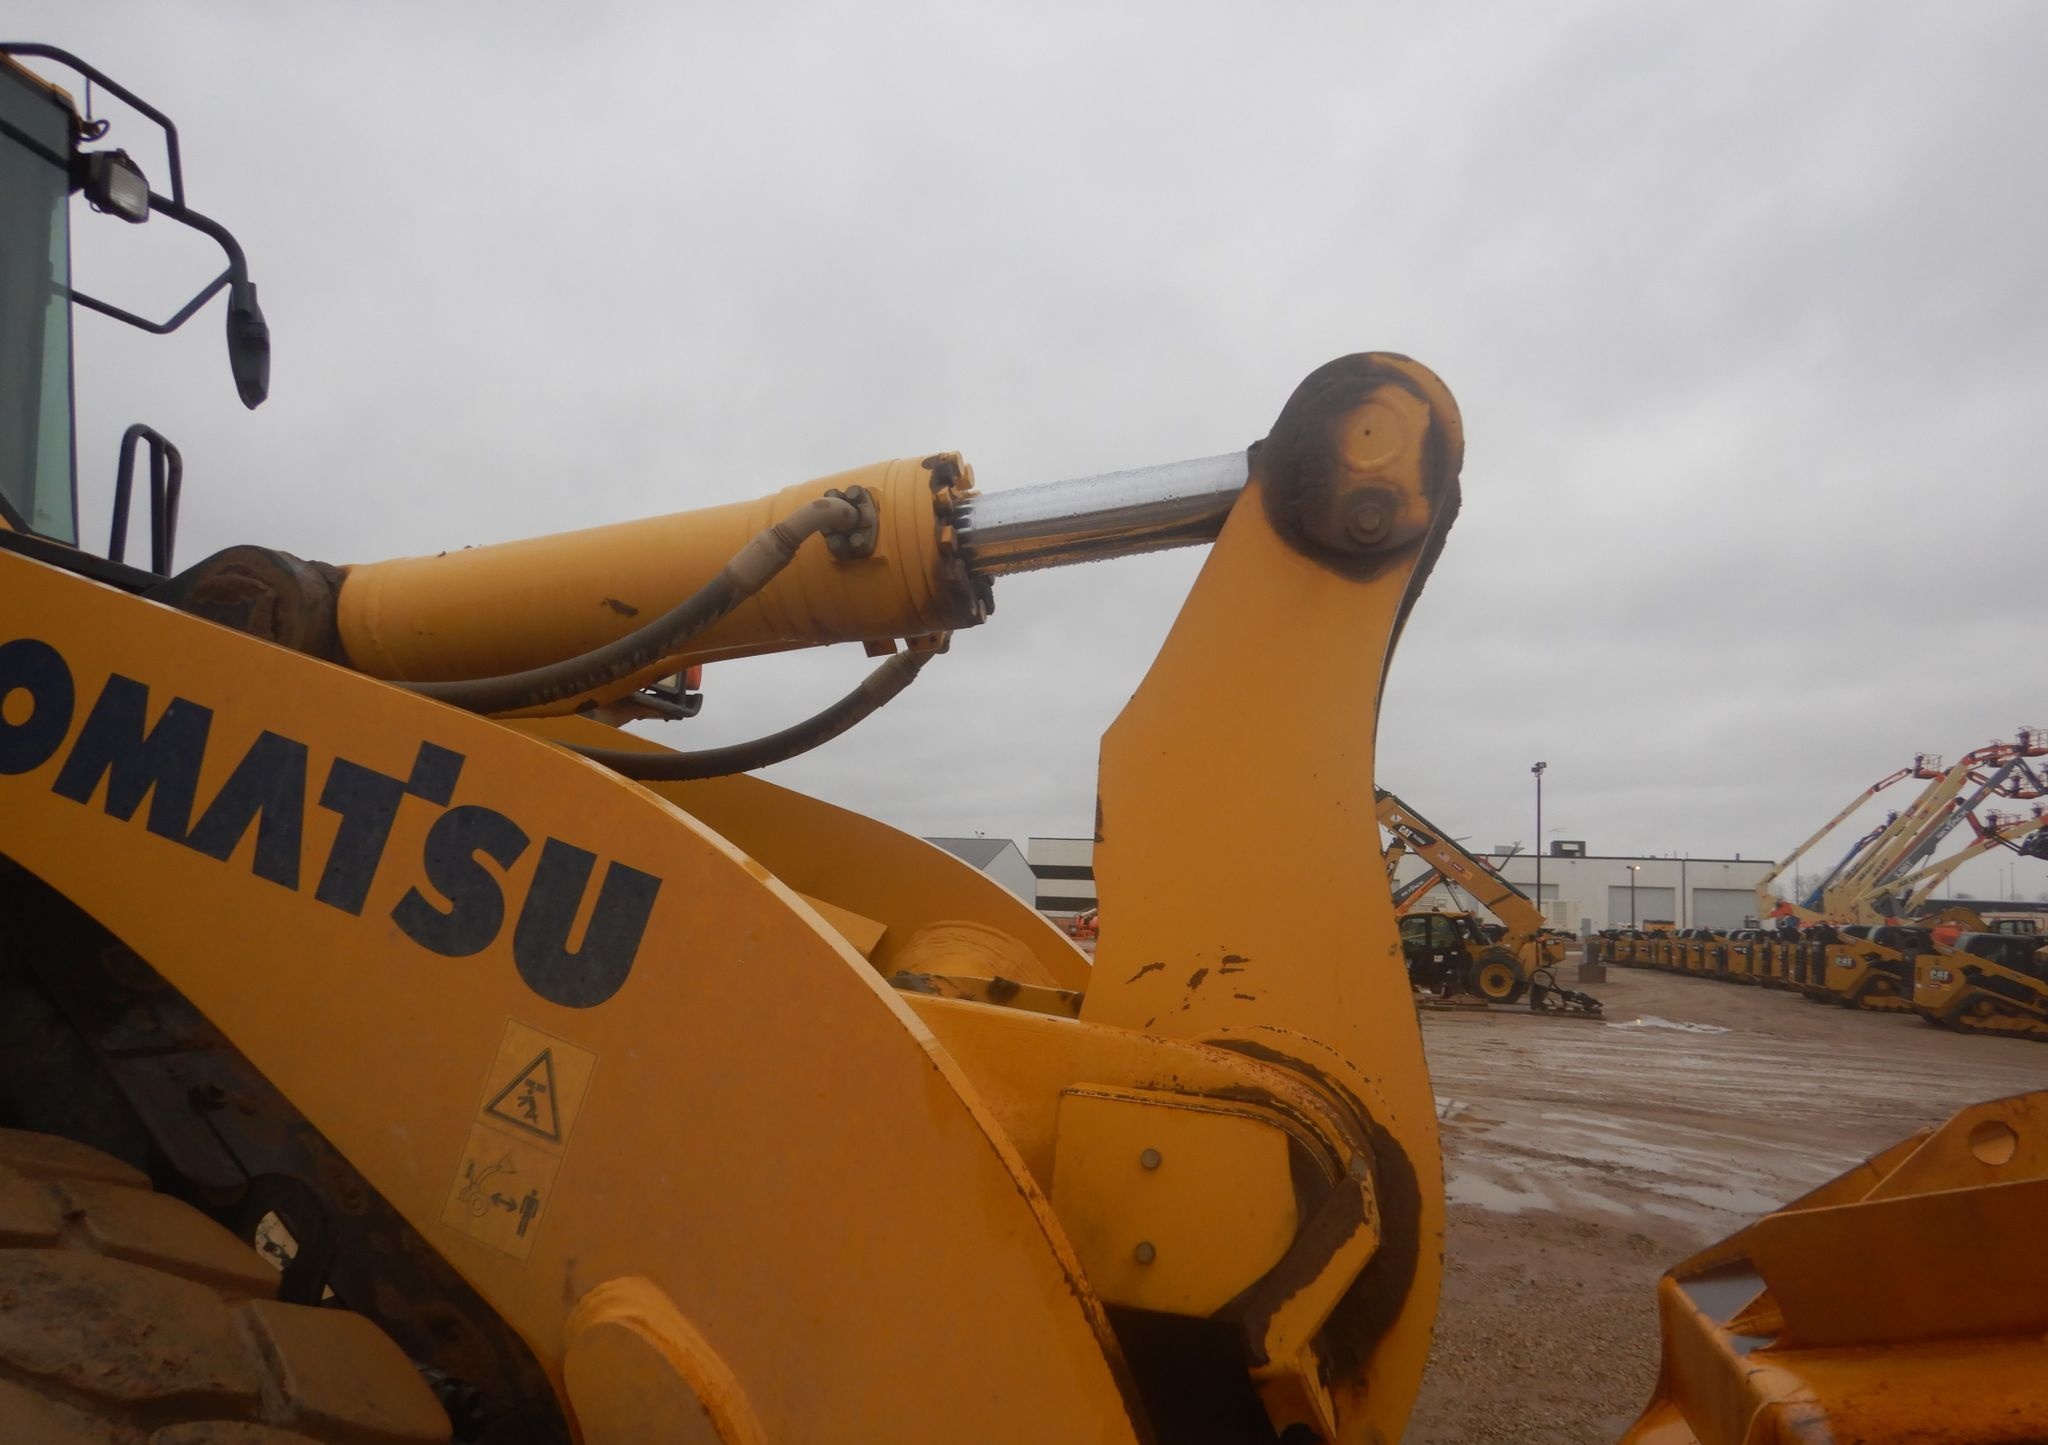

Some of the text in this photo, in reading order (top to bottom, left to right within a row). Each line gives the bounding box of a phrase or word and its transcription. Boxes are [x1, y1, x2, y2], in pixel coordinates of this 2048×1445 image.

[1398, 825, 1414, 838] CAT
[1835, 957, 1853, 968] CAT
[1930, 968, 1949, 981] CAT
